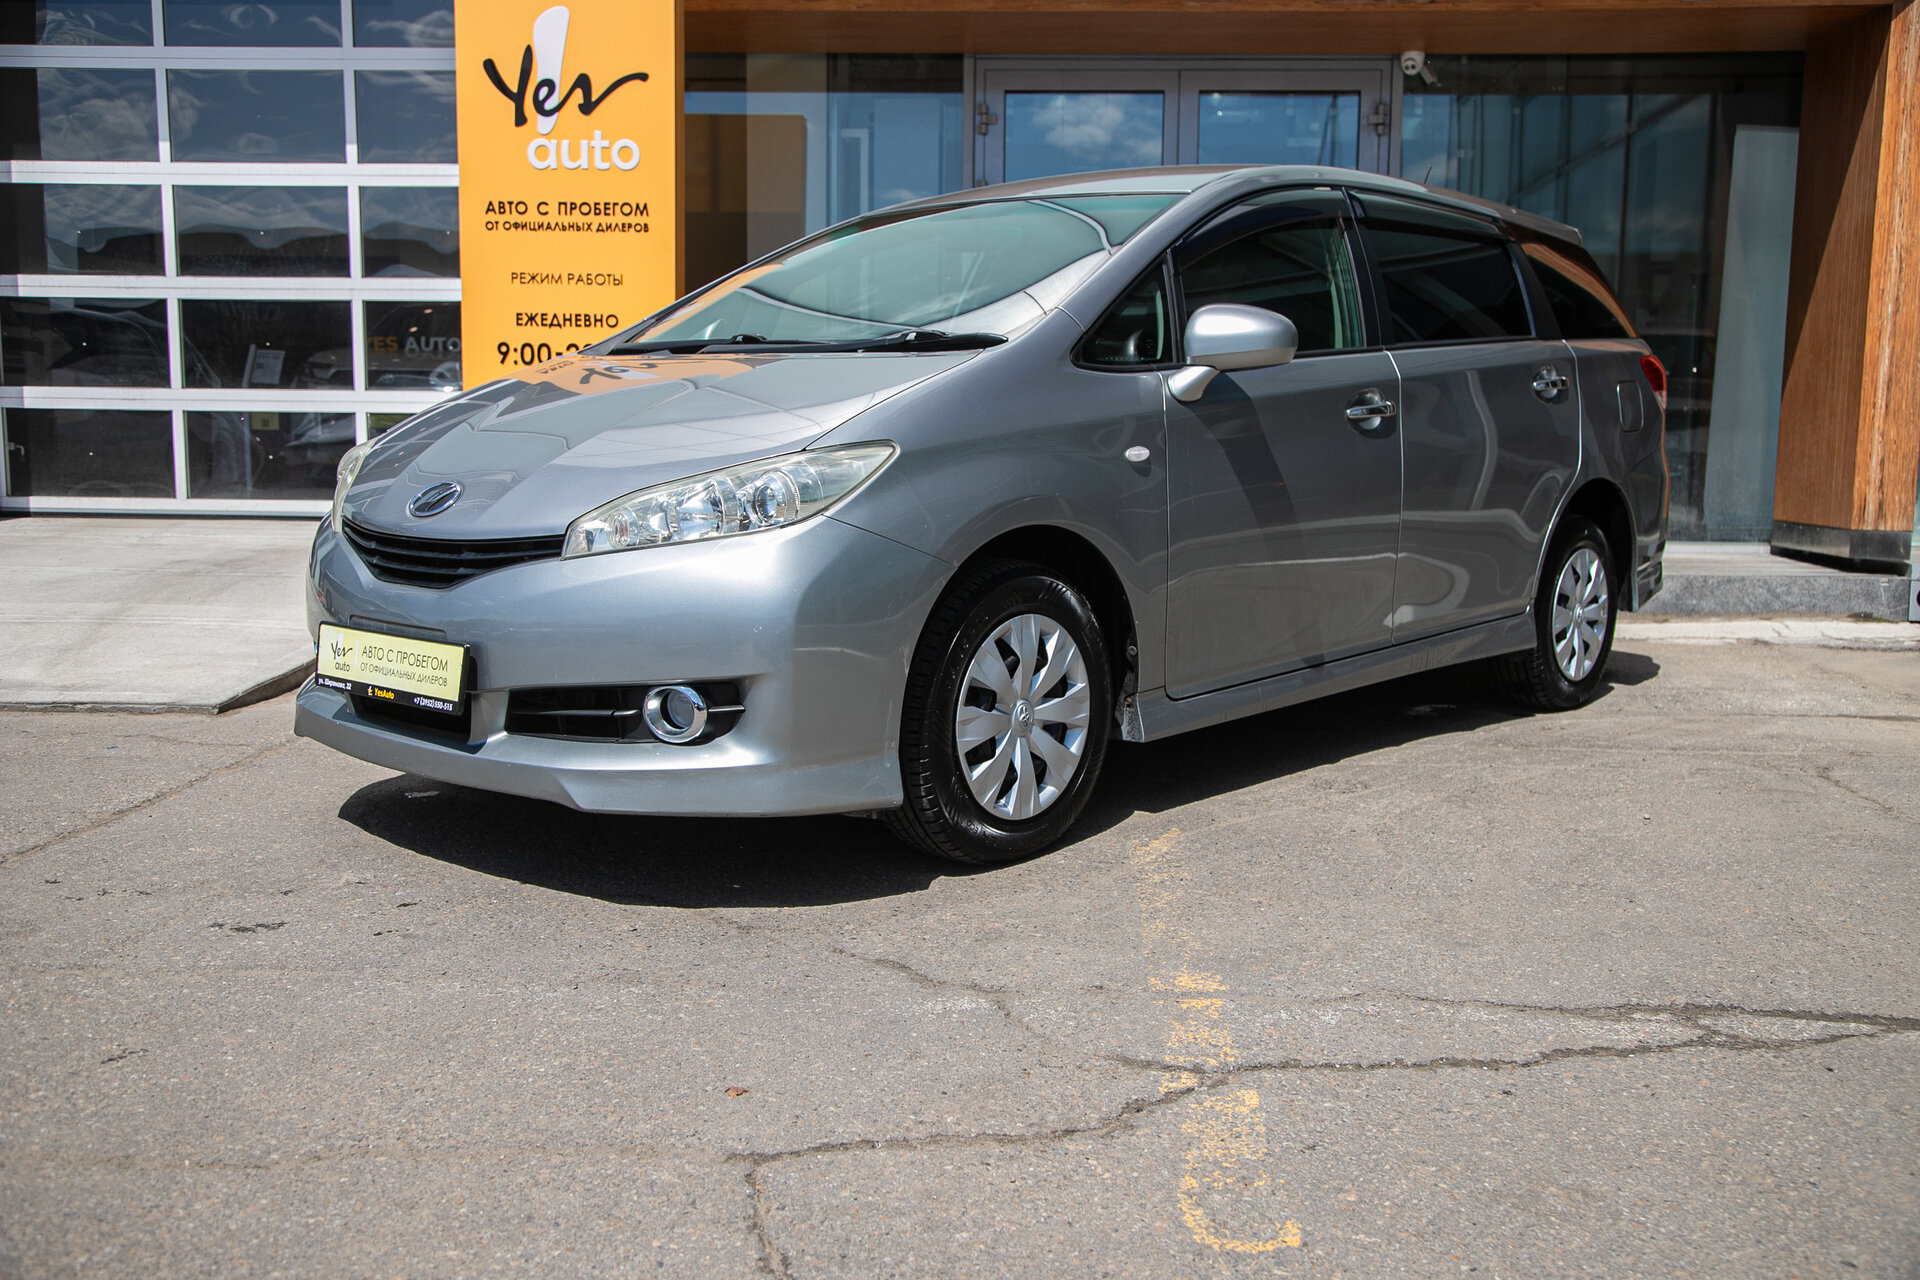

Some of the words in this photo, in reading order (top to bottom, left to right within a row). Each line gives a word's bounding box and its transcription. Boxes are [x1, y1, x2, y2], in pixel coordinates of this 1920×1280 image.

[482, 44, 649, 127] Yes
[527, 130, 640, 170] auto
[485, 201, 528, 215] АВТО
[537, 202, 549, 216] С
[558, 202, 649, 217] ПРОБЕГОМ
[485, 221, 499, 231] ОТ
[503, 221, 592, 232] ОФИЦИАЛЬНЫХ
[596, 223, 649, 233] ДИЛЕРОВ
[511, 272, 562, 285] РЕЖИМ
[567, 273, 624, 286] РАБОТЫ
[516, 313, 619, 328] ЕЖЕДНЕВНО
[404, 336, 461, 352] AUTO
[331, 641, 353, 659] Yes
[362, 645, 384, 660] АВТО
[387, 649, 394, 662] С
[396, 651, 448, 672] ПРОБЕГОМ
[335, 662, 350, 672] auto
[360, 662, 368, 671] ОТ
[369, 664, 416, 681] ОФИЦИАЛЬНЫХ
[417, 676, 448, 687] ДИЛЕРОВ
[374, 687, 395, 700] YesAuto
